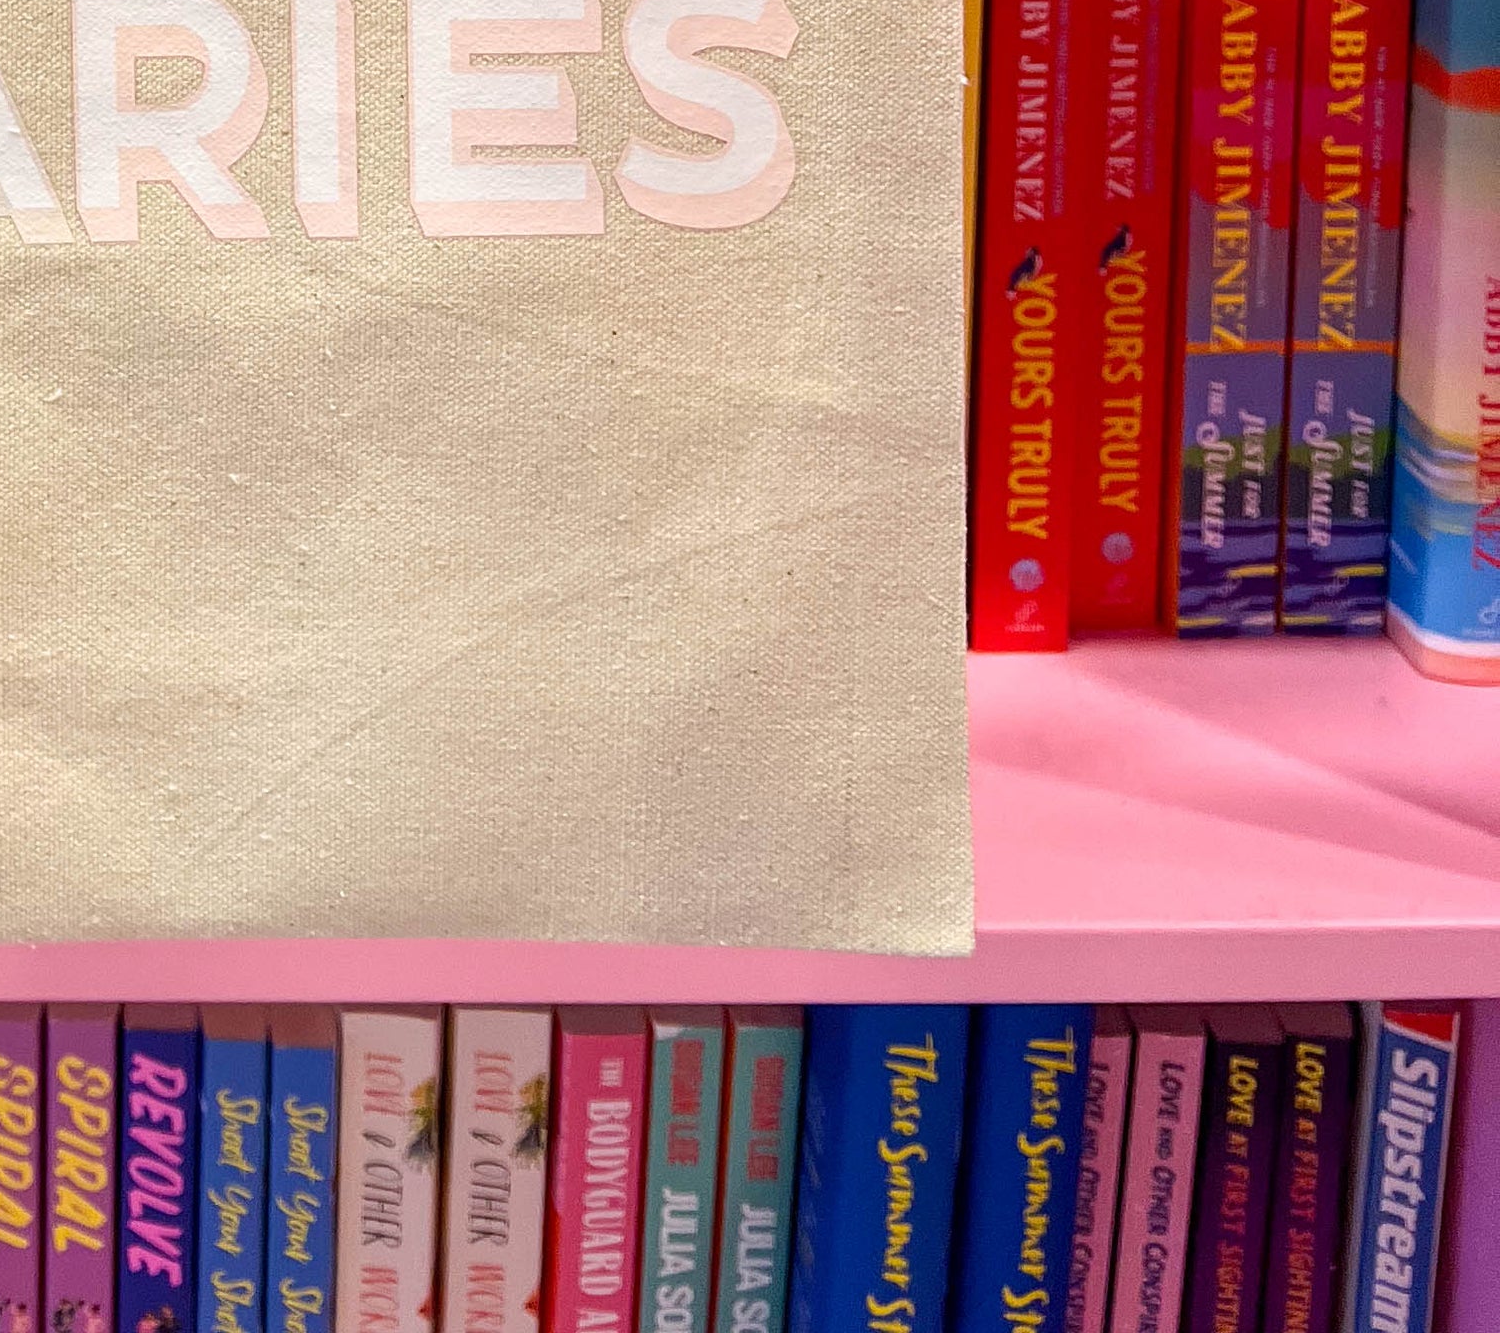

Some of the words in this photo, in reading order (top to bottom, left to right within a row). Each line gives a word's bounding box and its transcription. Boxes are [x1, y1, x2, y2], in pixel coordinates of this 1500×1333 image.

[1014, 54, 1049, 222] JIMENEZ
[1105, 34, 1138, 200] JIMENEZ
[1210, 137, 1253, 352] JIMENEZ
[1318, 135, 1362, 351] JIMENEZ
[1010, 272, 1058, 409] YOURS
[1101, 250, 1146, 385] YOURS
[1006, 418, 1052, 540] TRULY
[1100, 395, 1142, 514] TRULY
[884, 1031, 939, 1136] These
[1023, 1025, 1077, 1130] These
[1226, 1054, 1260, 1128] LOVE
[1293, 1041, 1327, 1114] LOVE
[53, 1055, 112, 1252] SPIRAL
[126, 1052, 188, 1288] REVOLVE
[579, 1099, 632, 1296] BODYGUARD
[878, 1137, 928, 1291] Summer
[1017, 1131, 1065, 1281] Summer
[1369, 1048, 1440, 1333] Slipstream
[660, 1187, 699, 1279] JULIA
[736, 1202, 777, 1292] JULIA
